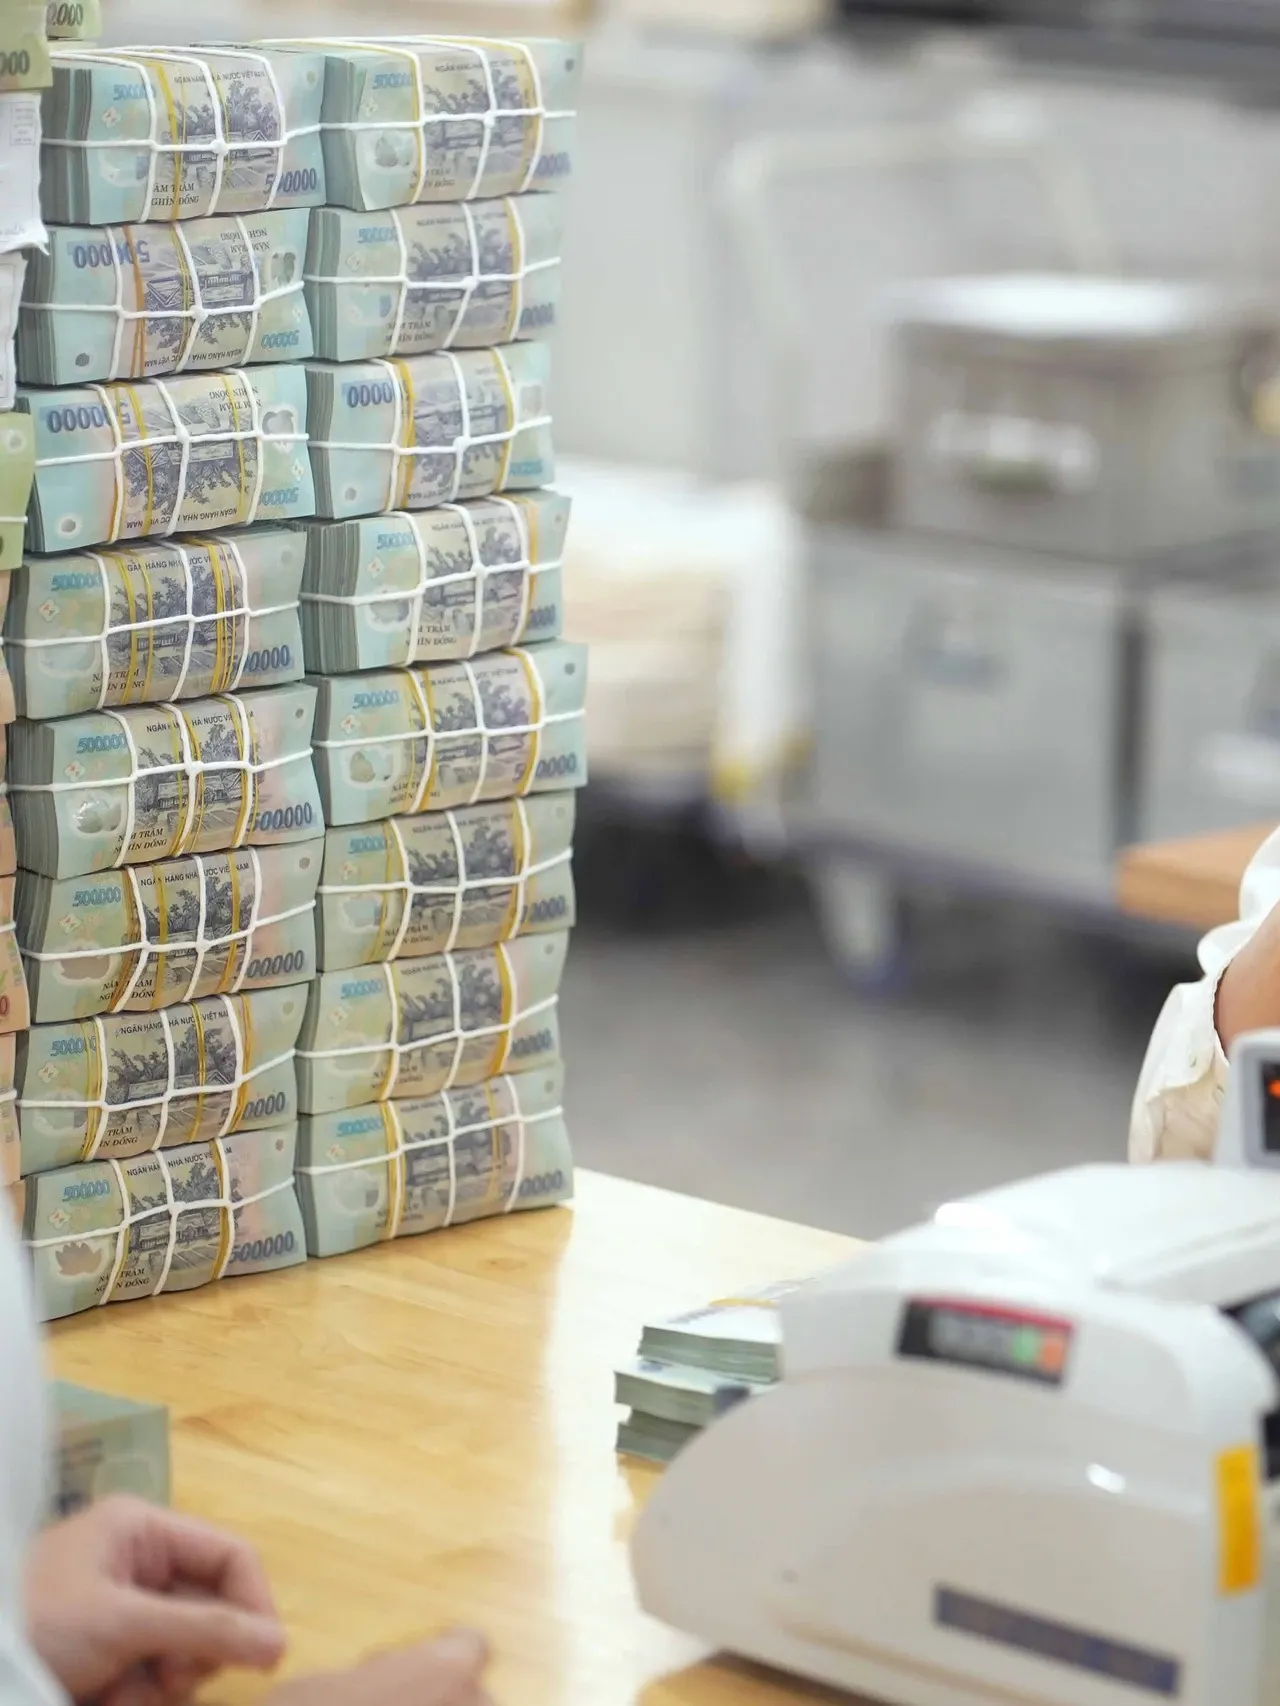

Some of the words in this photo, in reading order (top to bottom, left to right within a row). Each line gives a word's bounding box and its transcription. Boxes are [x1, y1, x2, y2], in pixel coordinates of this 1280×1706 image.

[262, 167, 317, 194] 50000
[153, 182, 168, 193] ĂM
[151, 195, 175, 207] GHÌN
[191, 715, 203, 727] HÀ
[139, 827, 163, 839] TRĂM
[143, 838, 167, 849] ĐỒNG
[165, 872, 185, 884] HÀNG
[237, 950, 304, 978] 00000
[120, 1023, 143, 1036] NGÂN
[169, 1016, 180, 1027] HÀ
[203, 1010, 218, 1022] VIỆT
[107, 1125, 133, 1136] TRĂM
[112, 1135, 138, 1147] ĐỒNG
[127, 1165, 149, 1177] NGÂN
[168, 1157, 183, 1168] NHÀ
[184, 1152, 203, 1165] NƯỚC
[125, 1277, 150, 1289] ĐỒNG
